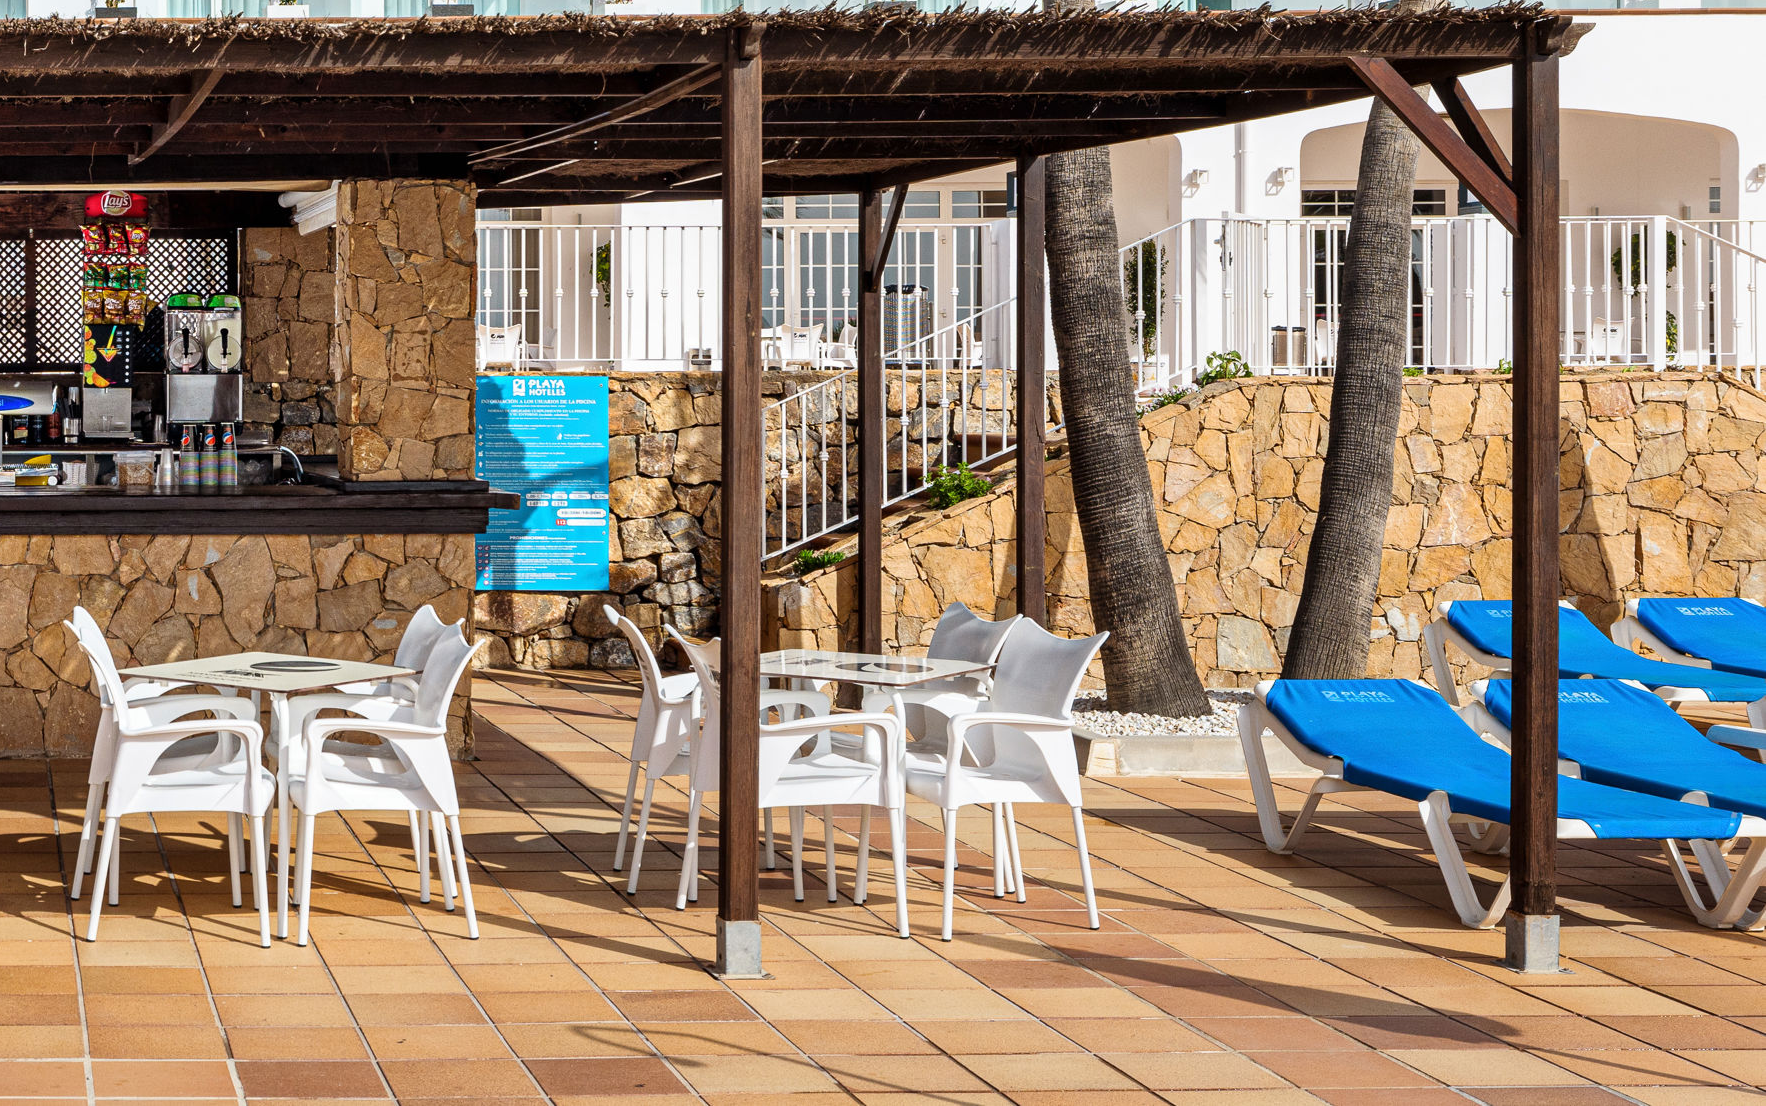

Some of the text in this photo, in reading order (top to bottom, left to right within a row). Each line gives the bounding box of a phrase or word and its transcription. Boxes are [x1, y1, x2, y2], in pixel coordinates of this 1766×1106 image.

[104, 194, 130, 208] Lay's
[528, 379, 565, 389] PLAYA
[529, 388, 566, 396] HOTELES
